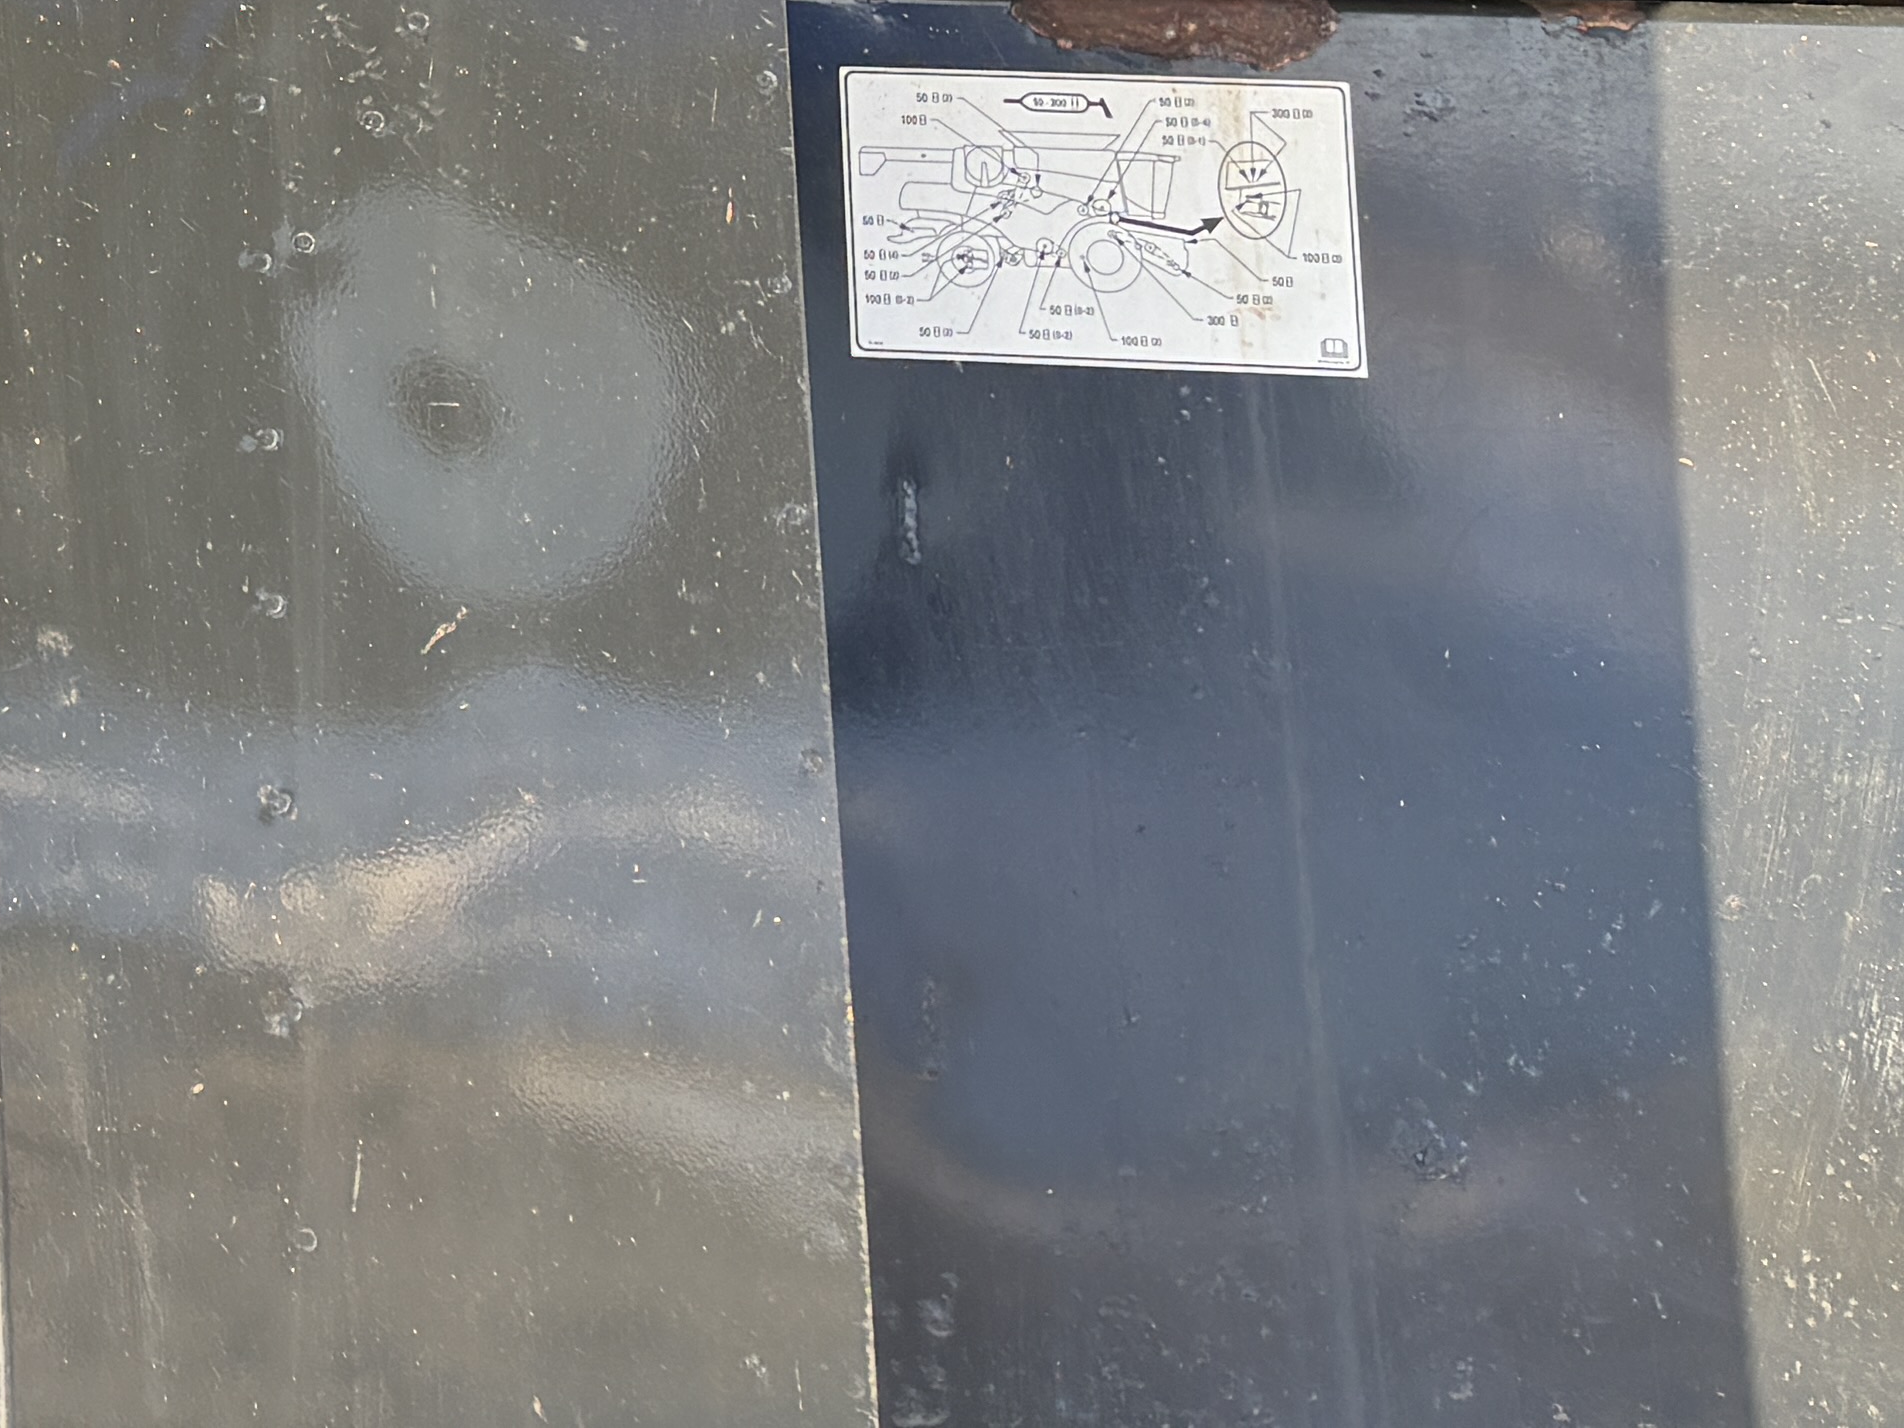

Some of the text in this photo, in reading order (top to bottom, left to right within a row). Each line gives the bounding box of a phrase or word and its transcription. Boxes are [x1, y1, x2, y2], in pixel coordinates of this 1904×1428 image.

[901, 114, 918, 125] 100
[1303, 252, 1320, 263] 100
[1272, 276, 1284, 287] 50
